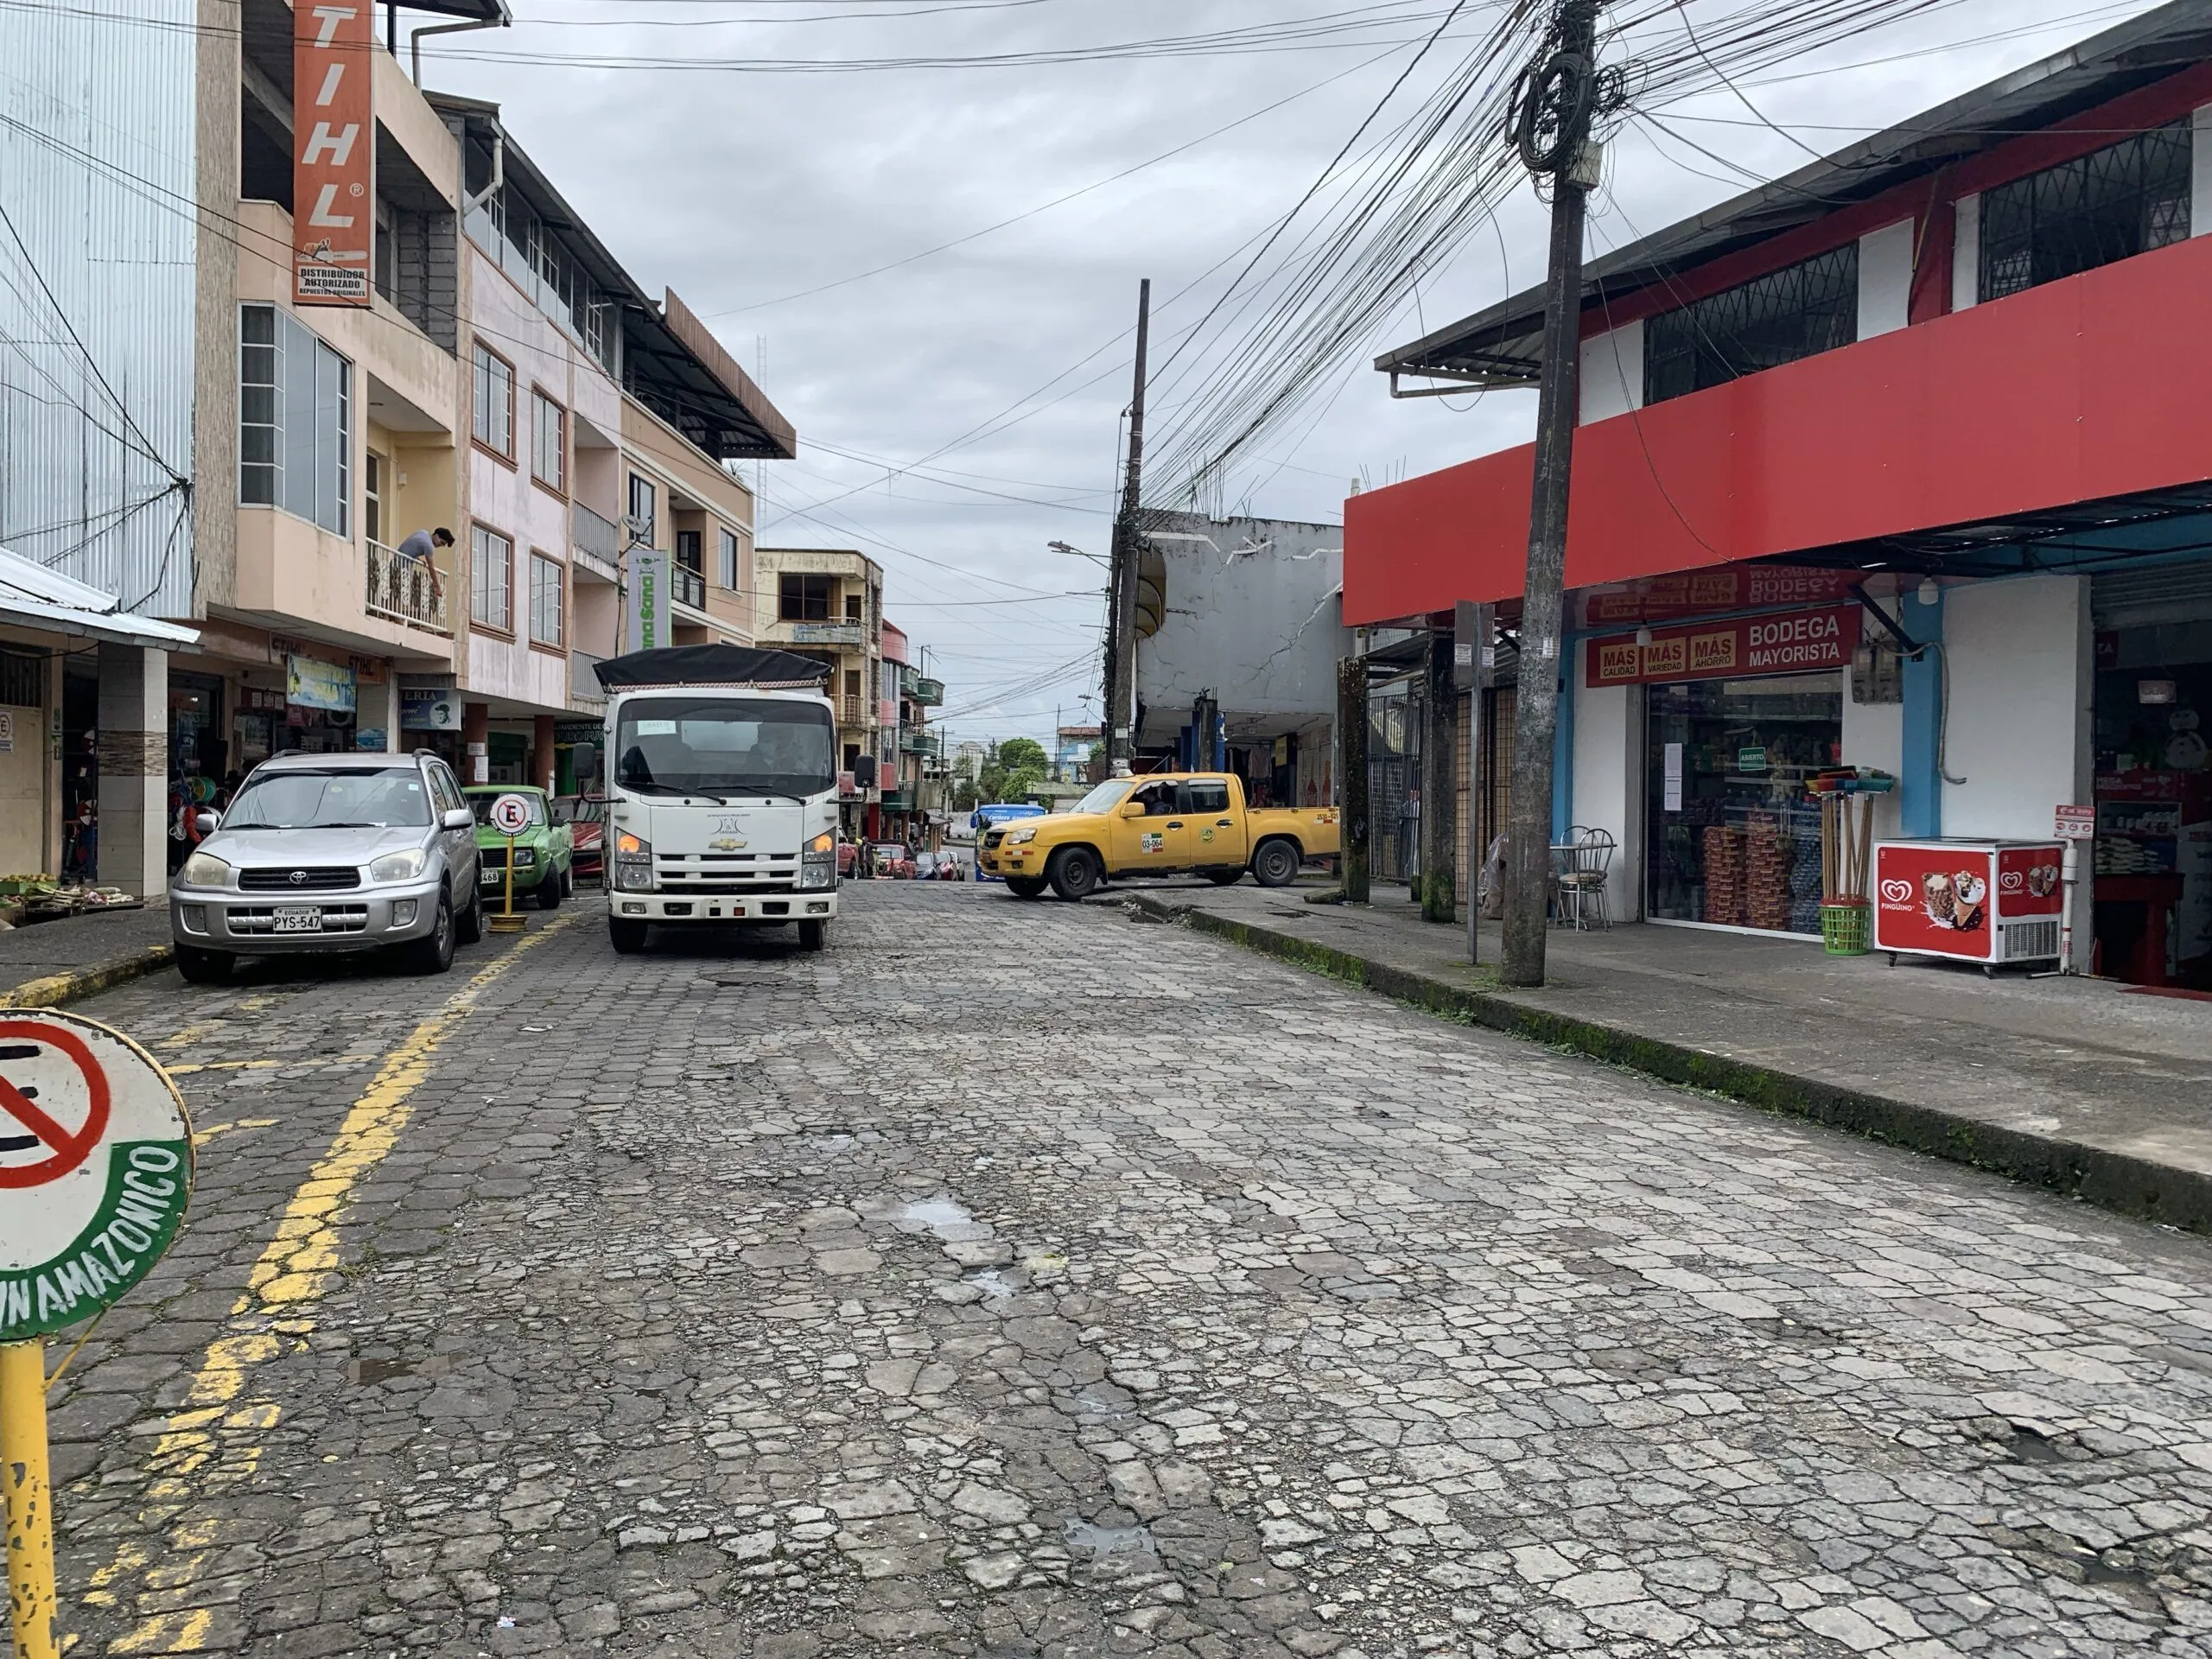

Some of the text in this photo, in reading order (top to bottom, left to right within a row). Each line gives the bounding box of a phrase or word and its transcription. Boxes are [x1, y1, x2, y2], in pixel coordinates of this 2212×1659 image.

[301, 268, 365, 278] DISTRIBUIDOR
[305, 278, 360, 288] AUTORIZADO
[1749, 614, 1840, 646] BODEGA
[1648, 642, 1681, 663] MÁS
[1694, 636, 1732, 658] MÁS
[1603, 647, 1636, 667] MÁS
[1749, 642, 1840, 667] MAYORISTA
[1648, 662, 1681, 672] VARIEDAD
[1695, 655, 1732, 668] AHORRO
[1603, 666, 1636, 677] CALIDAD
[1881, 902, 1912, 912] PINGÜINO
[274, 916, 320, 929] PYS-547
